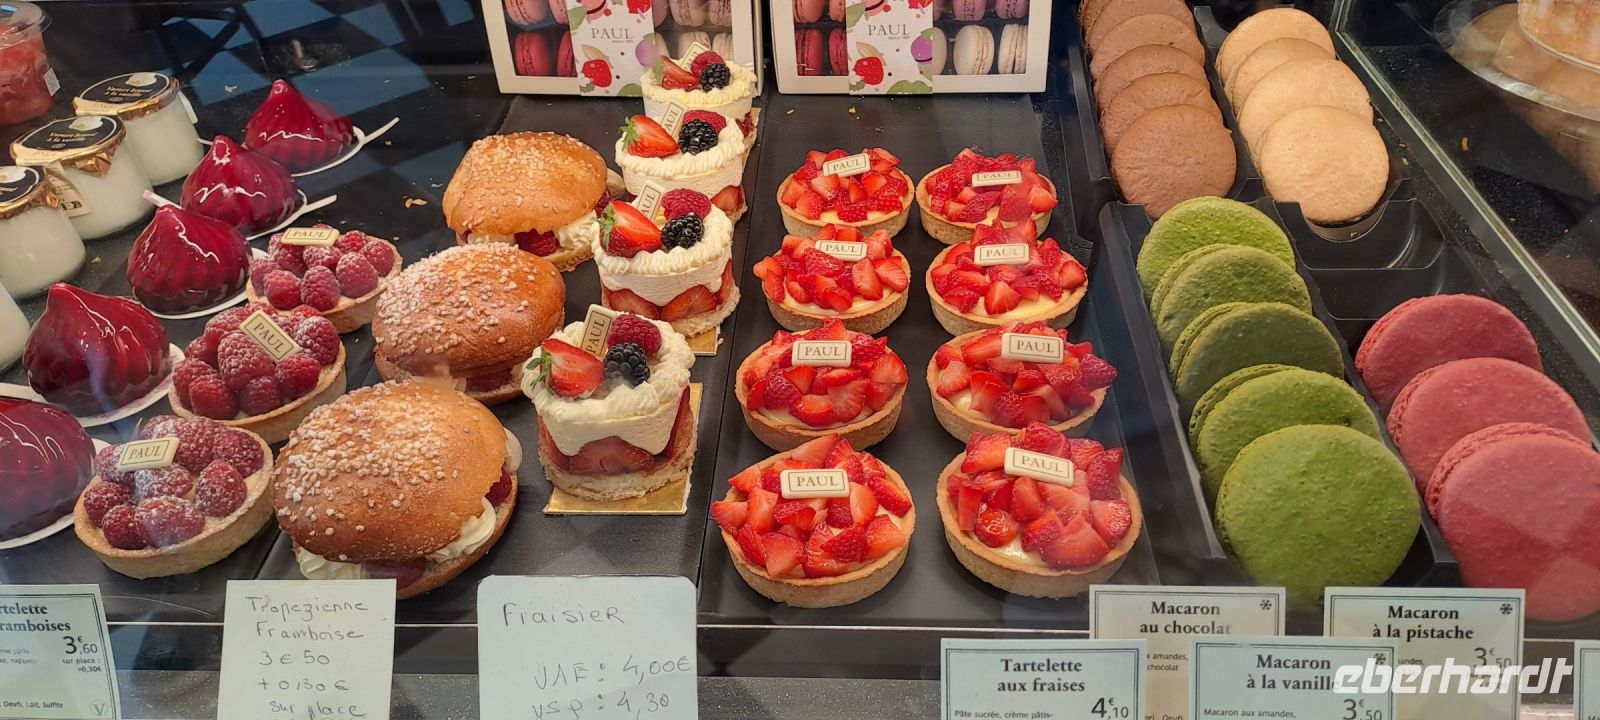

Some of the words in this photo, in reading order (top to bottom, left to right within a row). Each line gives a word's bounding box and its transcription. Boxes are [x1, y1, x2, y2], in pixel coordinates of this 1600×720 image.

[591, 28, 634, 39] PAUL
[868, 24, 911, 36] PAUL
[664, 110, 679, 132] AUL
[833, 159, 862, 172] PAUL
[826, 244, 857, 253] PAUL
[986, 248, 1021, 257] PAUL
[253, 322, 285, 353] PAUL
[586, 319, 605, 354] PAUL
[804, 346, 841, 356] PAUL
[1017, 340, 1055, 353] PAUL
[128, 446, 161, 460] PAUL
[1021, 455, 1063, 473] PAUL
[796, 475, 839, 487] PAUL
[1151, 600, 1221, 616] Macaron
[1387, 605, 1460, 620] Macaron
[256, 620, 364, 641] Framboise
[1139, 623, 1159, 634] au
[1163, 620, 1233, 636] chocolat
[1372, 624, 1382, 638] à
[1387, 625, 1401, 638] la
[1405, 625, 1474, 642] pistache
[1152, 653, 1188, 662] amandes,
[1256, 654, 1331, 670] Macaron
[1000, 658, 1083, 673] Tartelette
[997, 680, 1027, 692] aux
[1032, 677, 1086, 692] fraises
[1246, 676, 1257, 689] à
[1262, 674, 1277, 689] la
[954, 708, 973, 718] Pâte
[1203, 708, 1239, 717] Macaron
[1241, 709, 1255, 717] aux
[1257, 709, 1297, 719] amandes,
